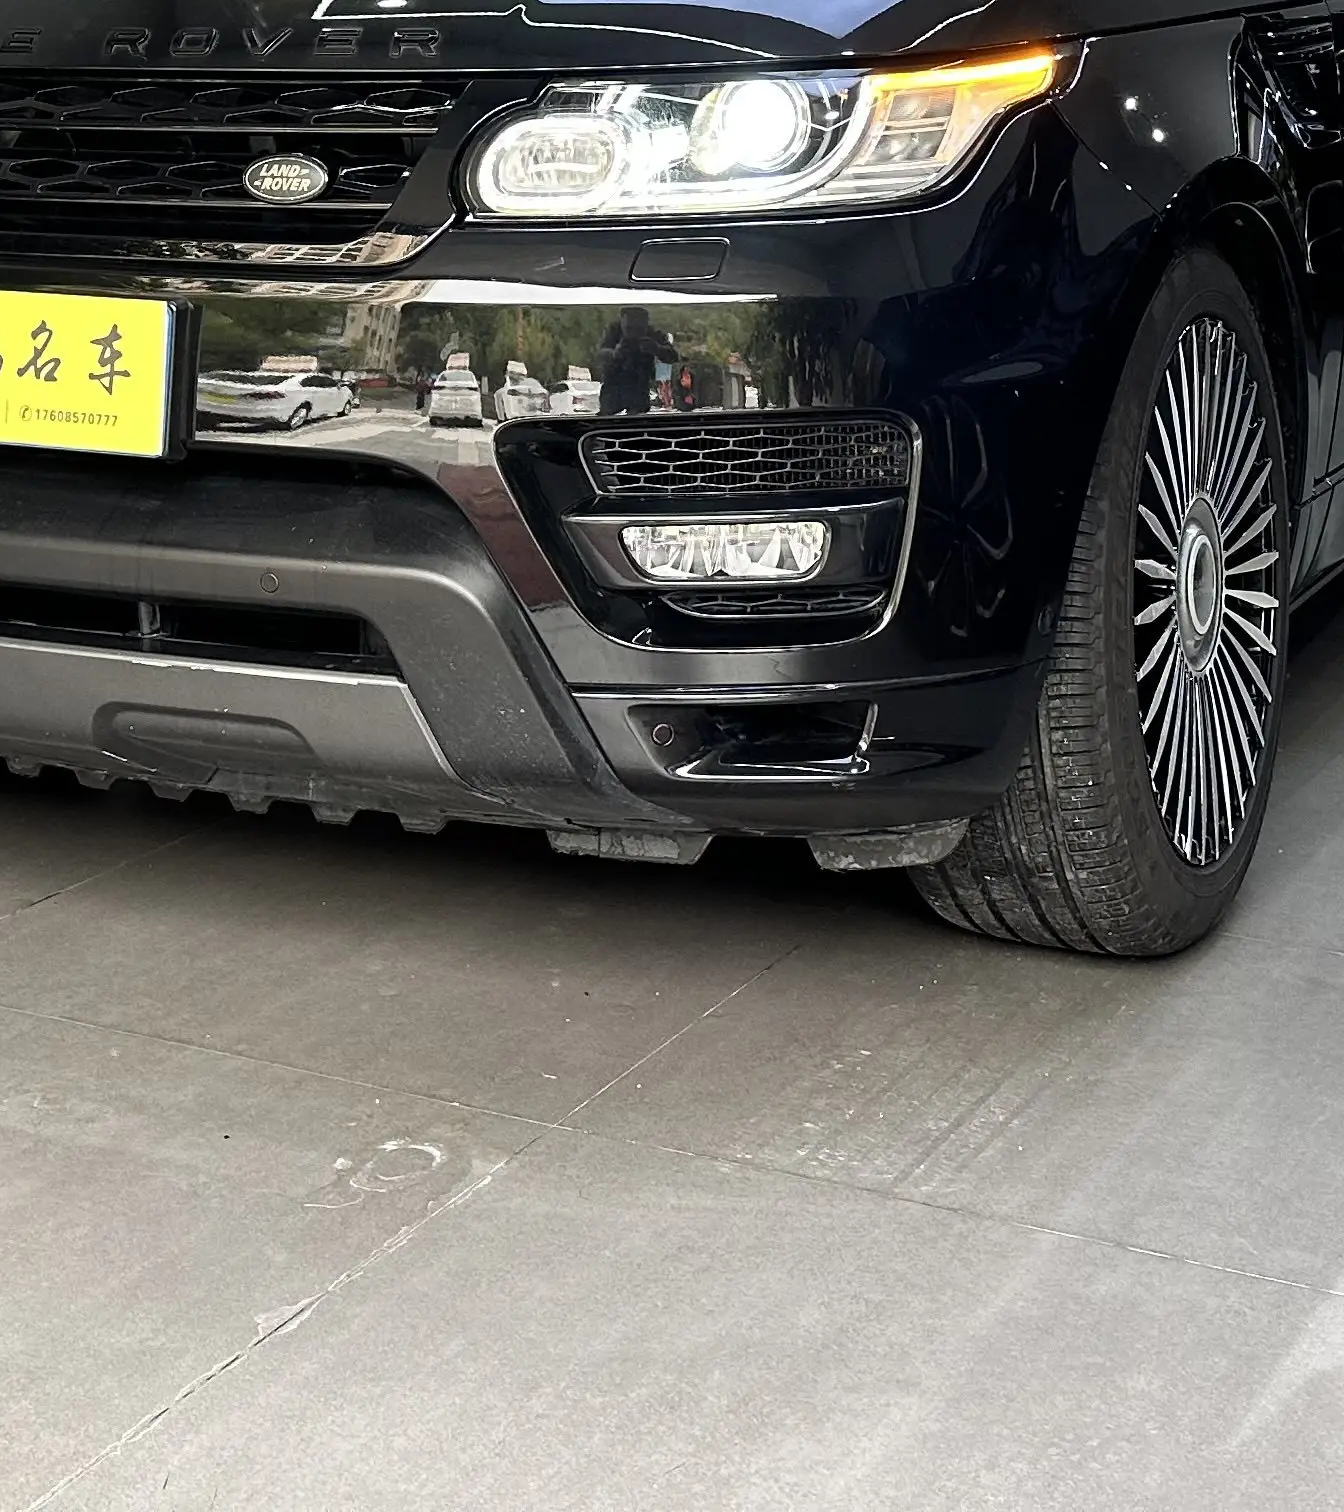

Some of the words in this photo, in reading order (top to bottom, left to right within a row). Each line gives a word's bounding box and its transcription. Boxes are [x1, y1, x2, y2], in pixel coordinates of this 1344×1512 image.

[104, 26, 442, 58] ROVER
[260, 163, 301, 177] LAND
[260, 177, 311, 191] ROVER
[35, 408, 118, 427] 17608570777
